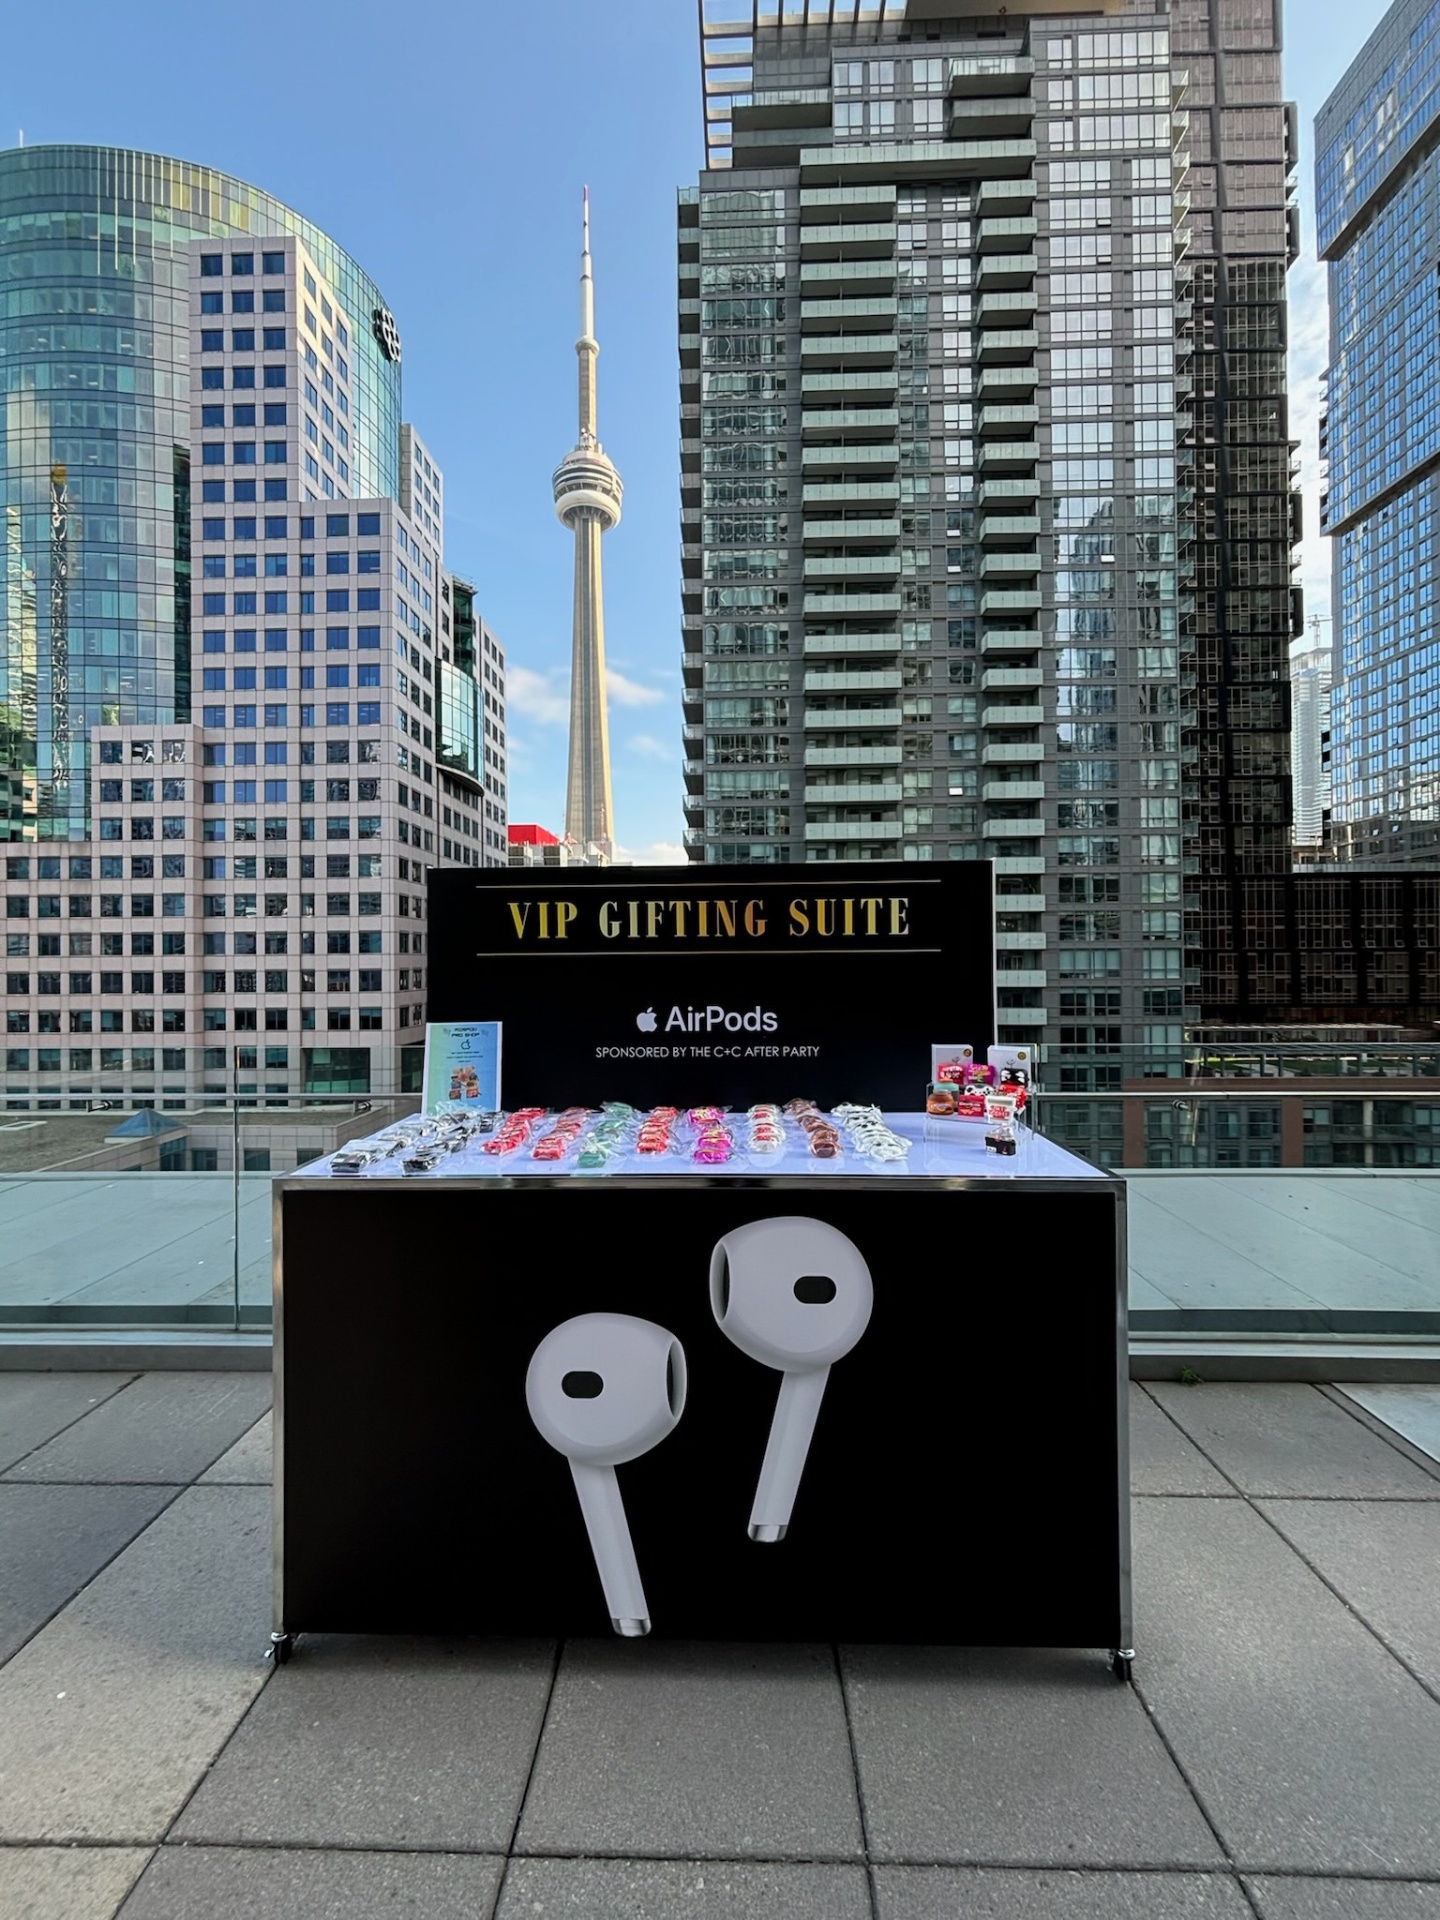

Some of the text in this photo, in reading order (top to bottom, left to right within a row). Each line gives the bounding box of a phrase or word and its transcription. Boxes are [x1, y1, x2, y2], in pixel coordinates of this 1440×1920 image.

[507, 897, 909, 939] VIP GIFTING SUITE
[664, 1005, 778, 1032] AirPods
[595, 1045, 820, 1058] SPONSORED BY THE C+C AFTER PARTY
